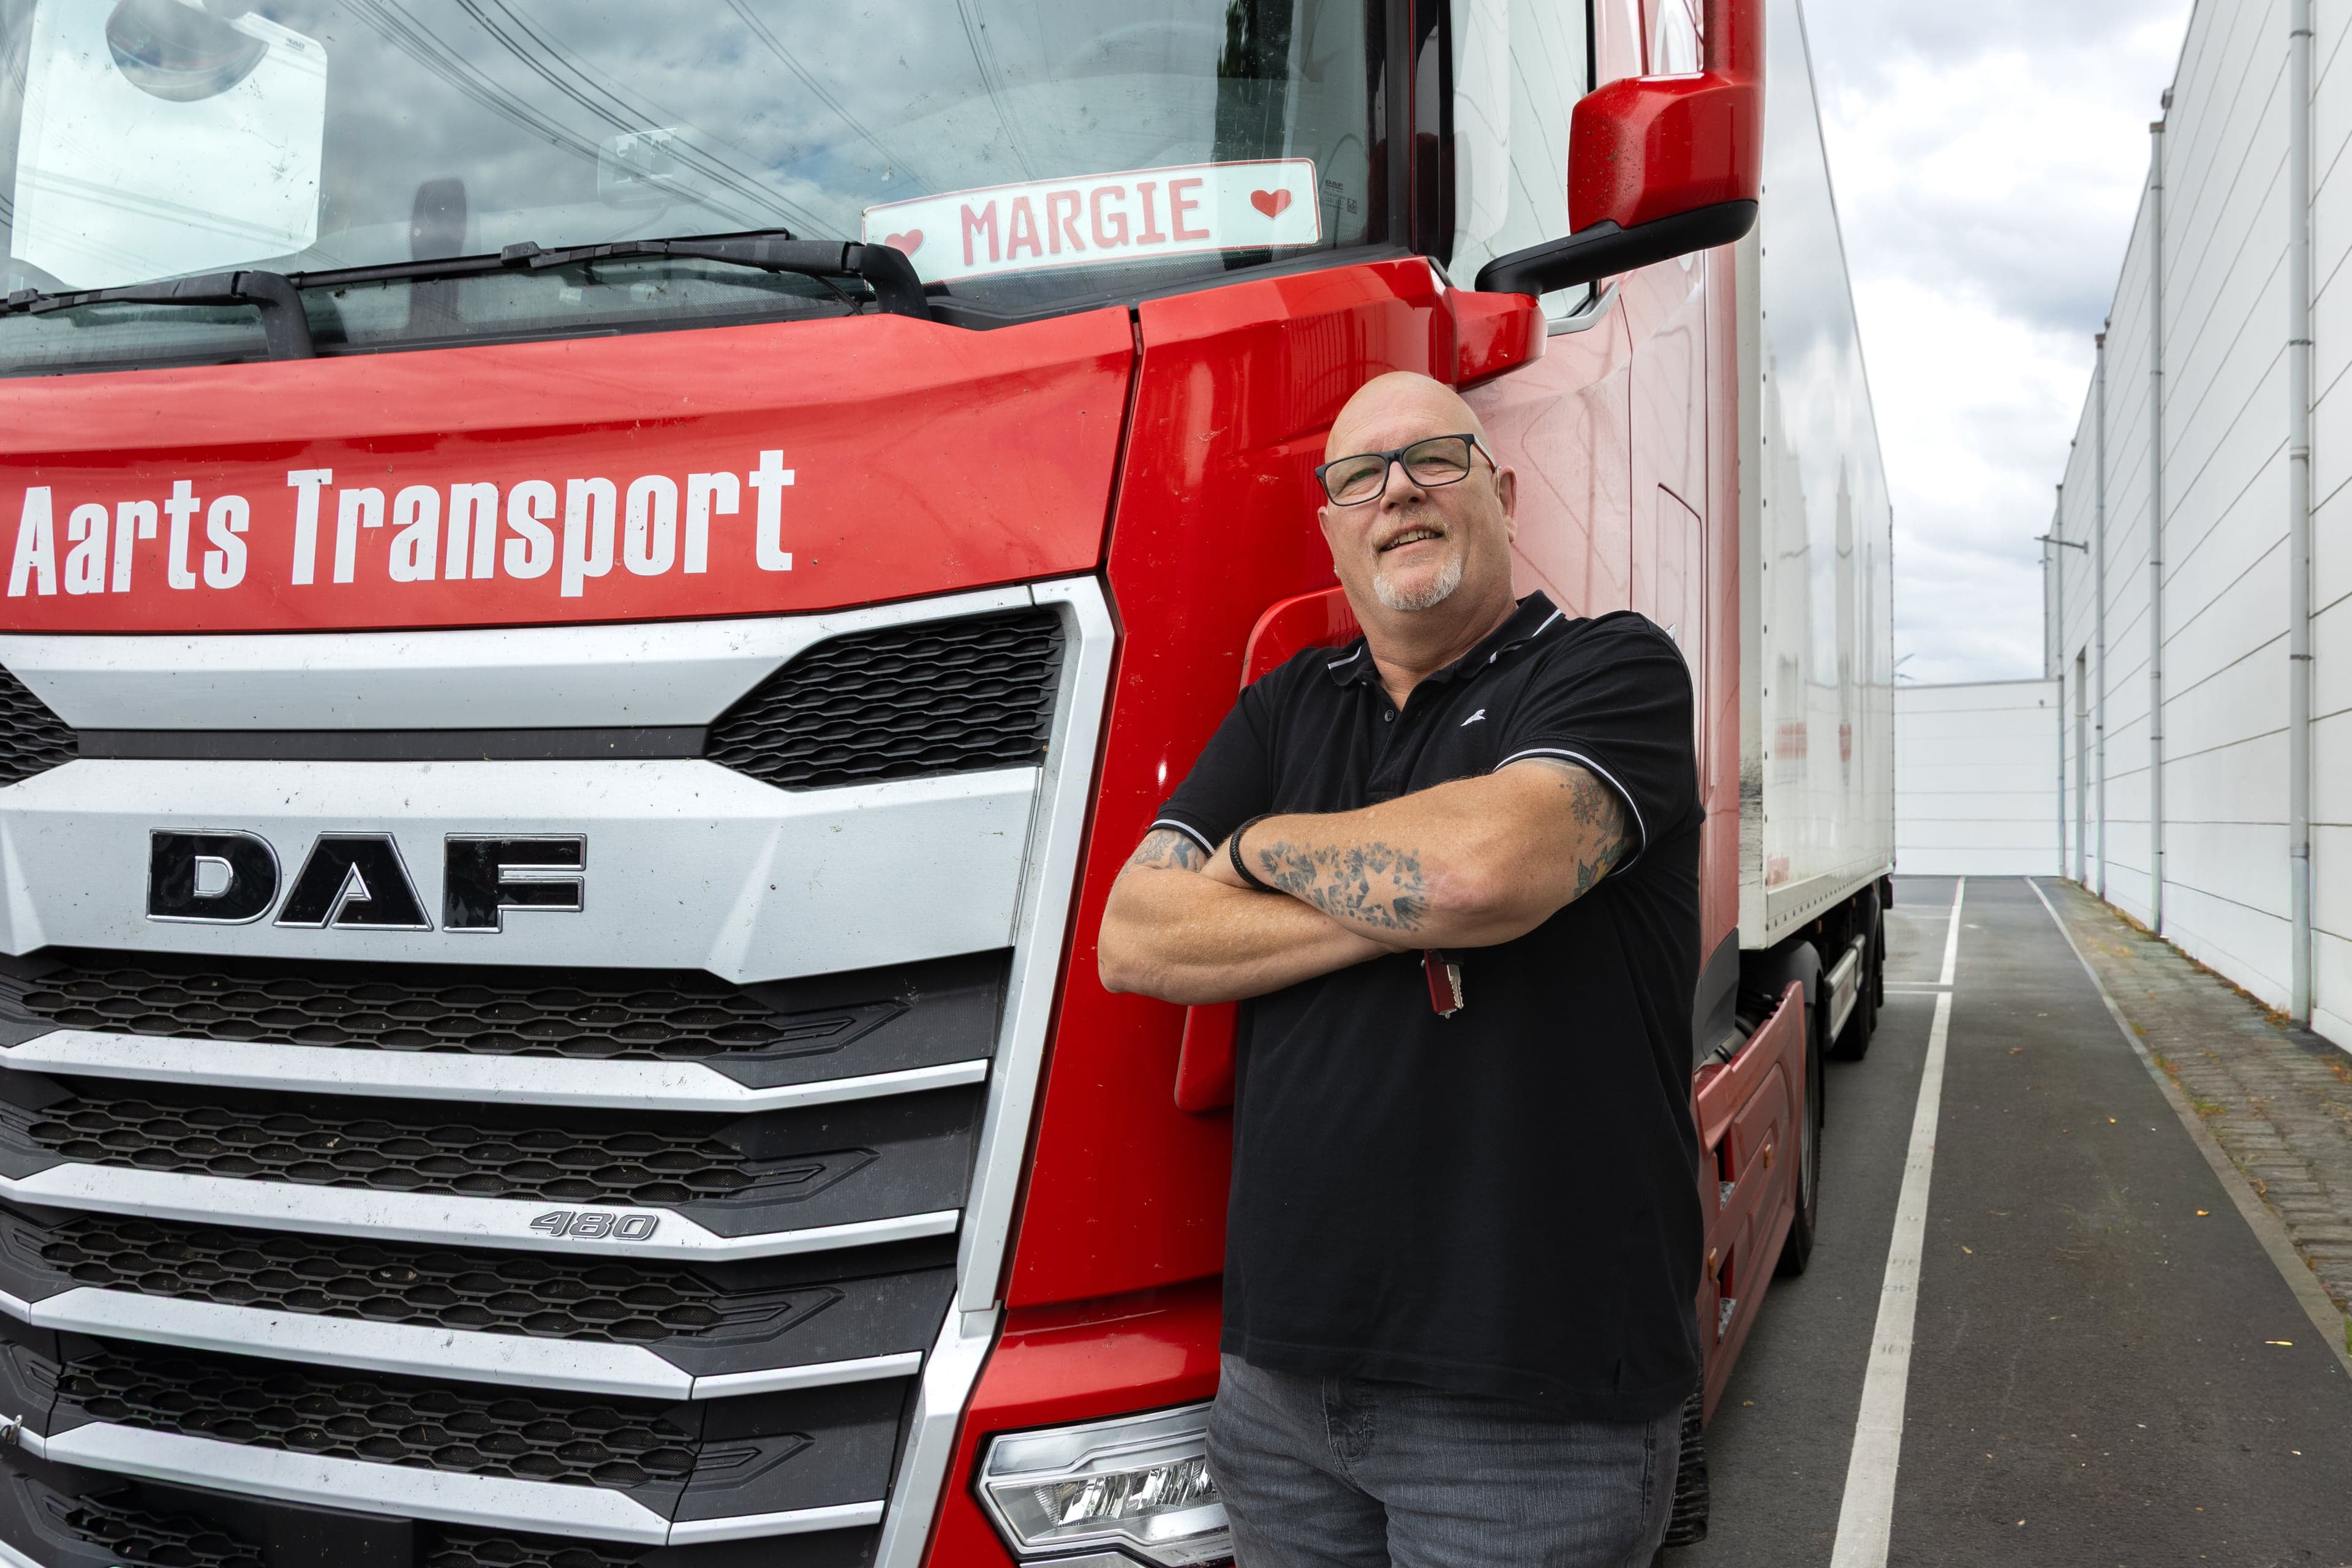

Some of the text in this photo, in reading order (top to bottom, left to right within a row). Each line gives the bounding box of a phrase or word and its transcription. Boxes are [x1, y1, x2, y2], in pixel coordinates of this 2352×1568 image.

[960, 176, 1210, 266] MARGIE
[7, 450, 795, 597] Aarts Transport
[145, 827, 587, 933] DAF
[529, 1210, 660, 1241] 480
